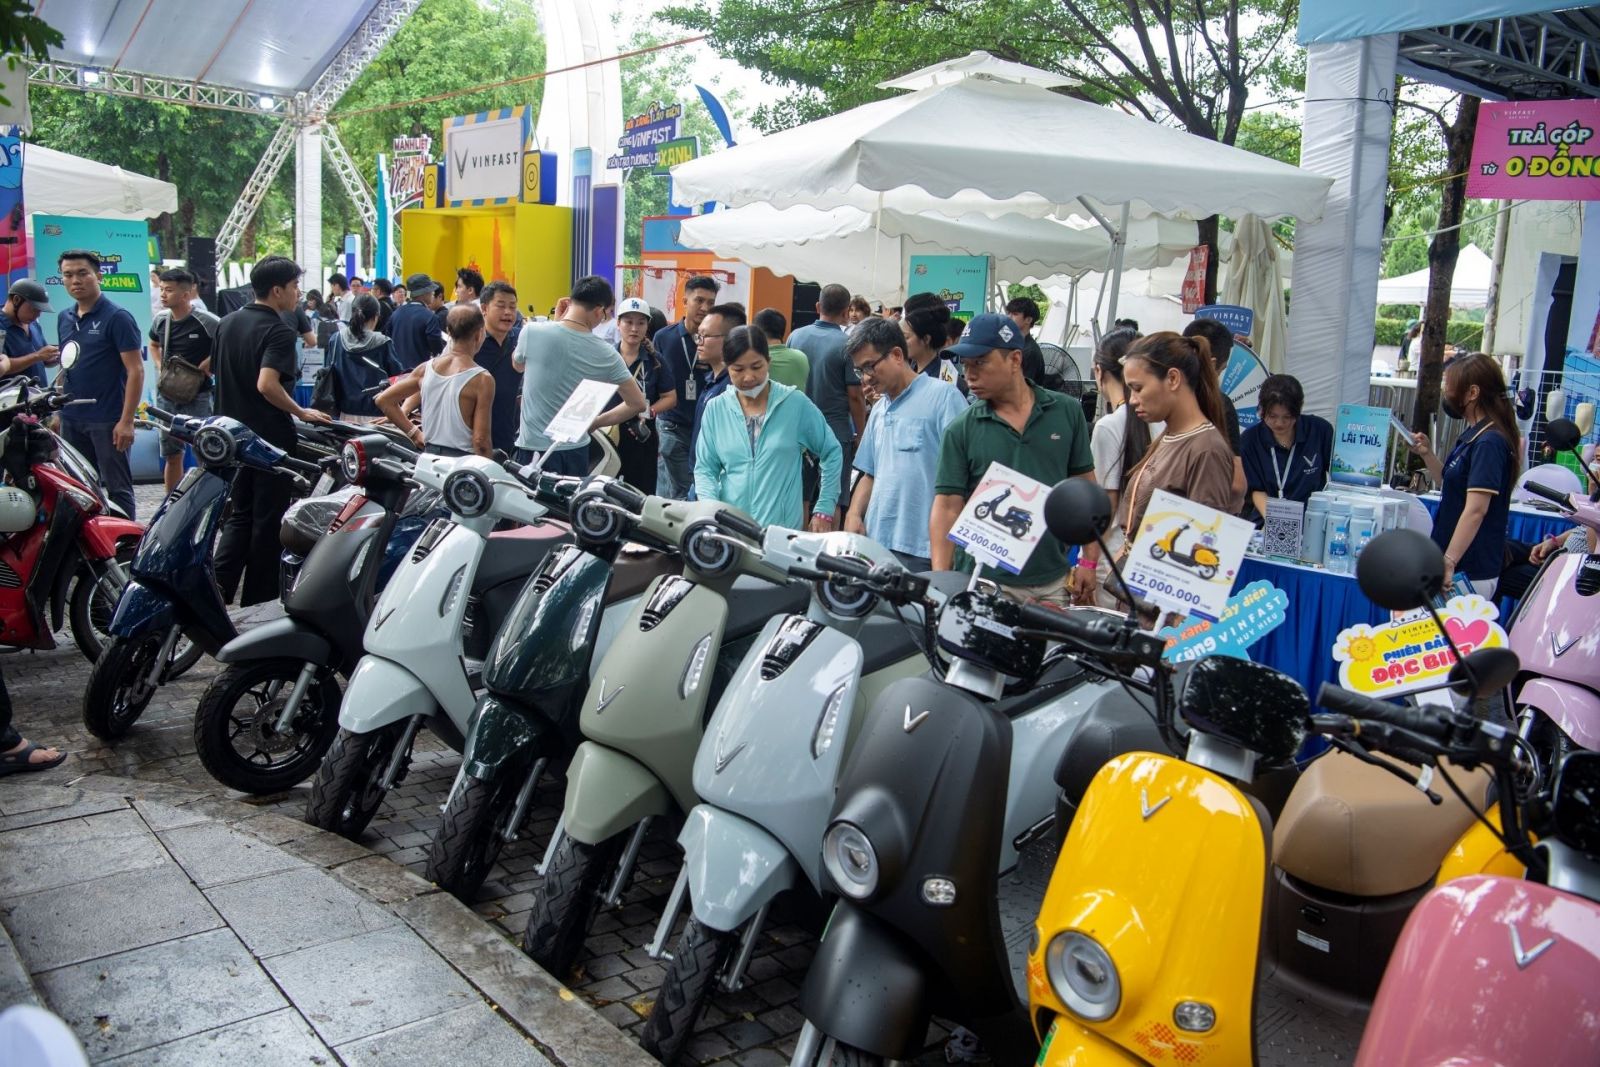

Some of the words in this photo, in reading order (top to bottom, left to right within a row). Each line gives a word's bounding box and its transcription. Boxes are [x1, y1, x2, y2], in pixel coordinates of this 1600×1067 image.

[1510, 123, 1546, 144] TRẢ
[1549, 122, 1592, 143] GÓP
[472, 151, 518, 168] VINFAST
[1482, 163, 1498, 175] TỪ
[103, 276, 137, 288] XANH
[1213, 312, 1250, 323] VINFAST
[956, 525, 1009, 558] 22.000.000
[1128, 571, 1201, 606] 12.000.000
[1218, 595, 1282, 643] VINFAST
[1402, 622, 1436, 635] VINFAS
[1383, 643, 1422, 663] PHIÊN
[1372, 660, 1420, 685] ĐẶC
